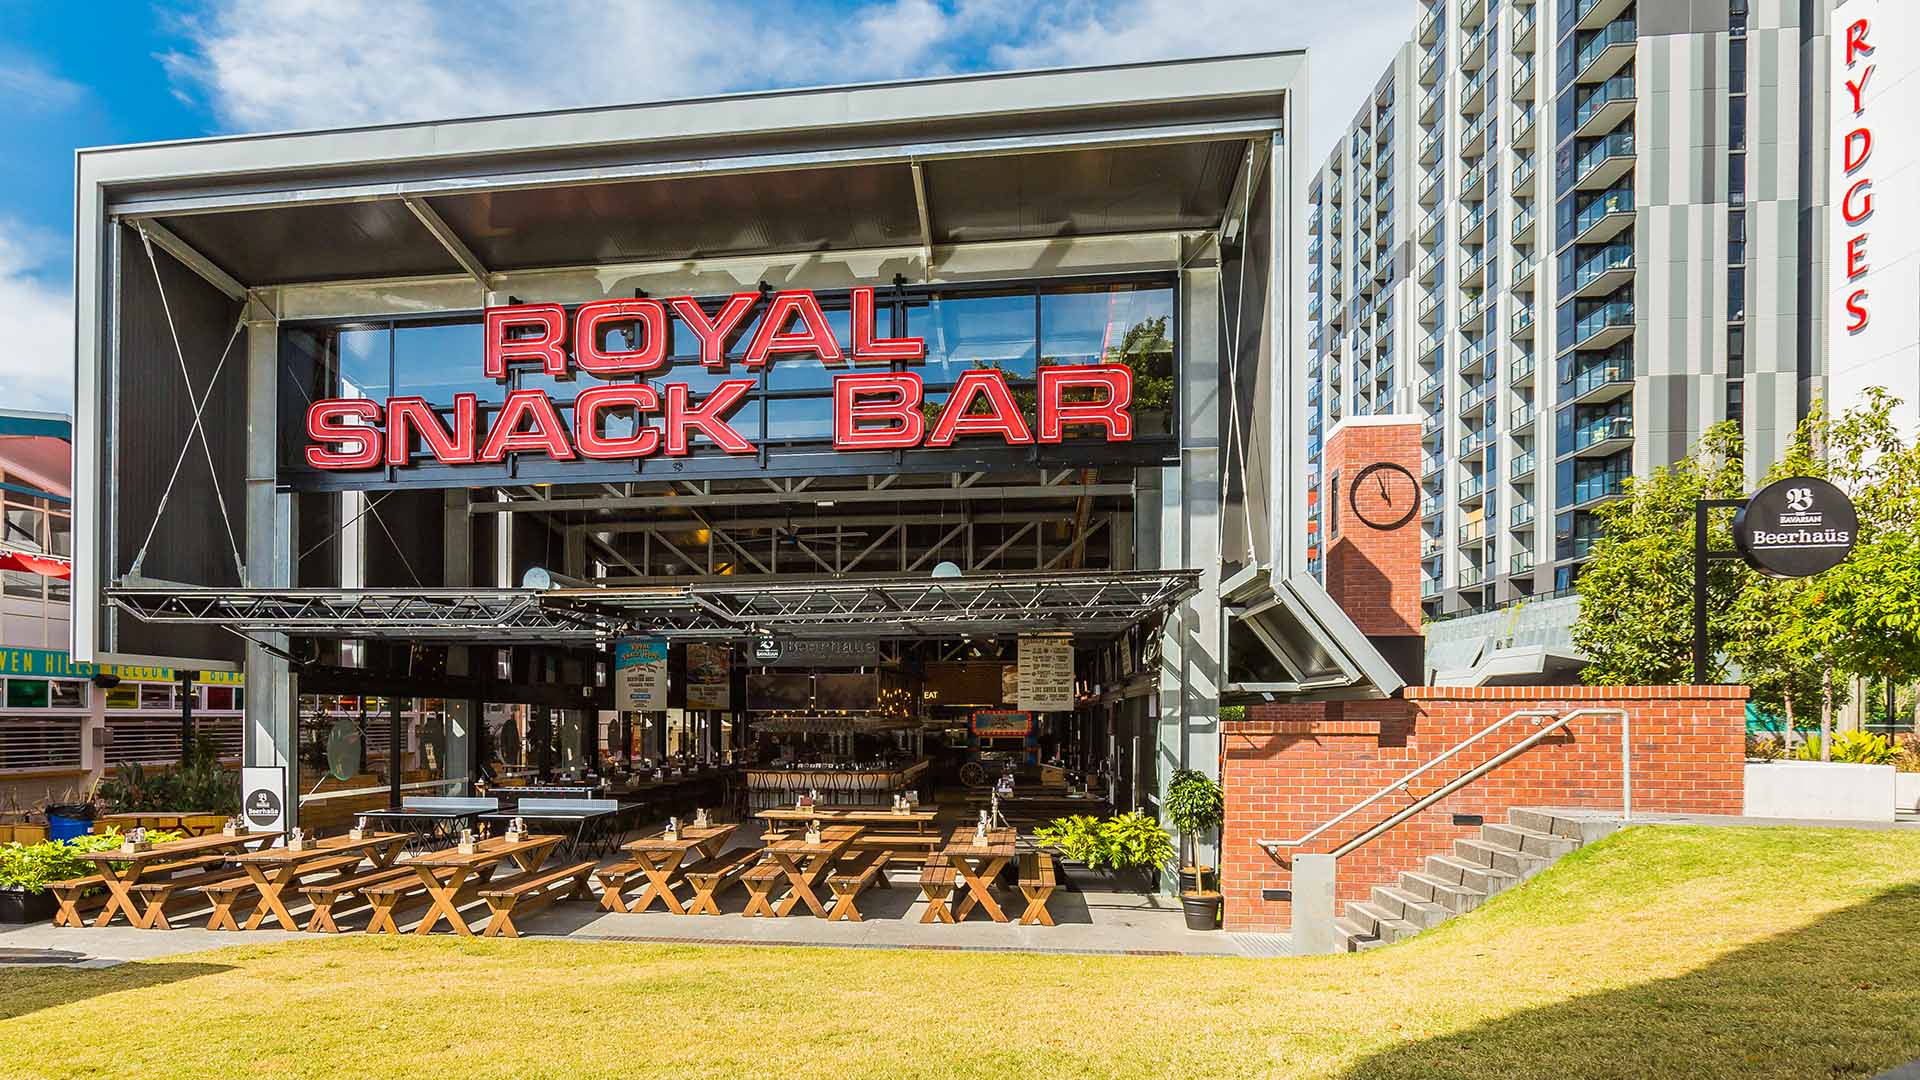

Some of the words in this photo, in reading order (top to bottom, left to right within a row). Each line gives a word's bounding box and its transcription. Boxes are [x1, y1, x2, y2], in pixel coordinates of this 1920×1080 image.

[1842, 18, 1876, 333] RYDGES
[484, 287, 925, 378] ROYAL
[305, 379, 758, 469] SNACK
[833, 363, 1133, 450] BAR
[1753, 529, 1849, 545] Beerhaüs
[1780, 516, 1822, 524] BAVARIAN
[924, 691, 938, 699] EAT
